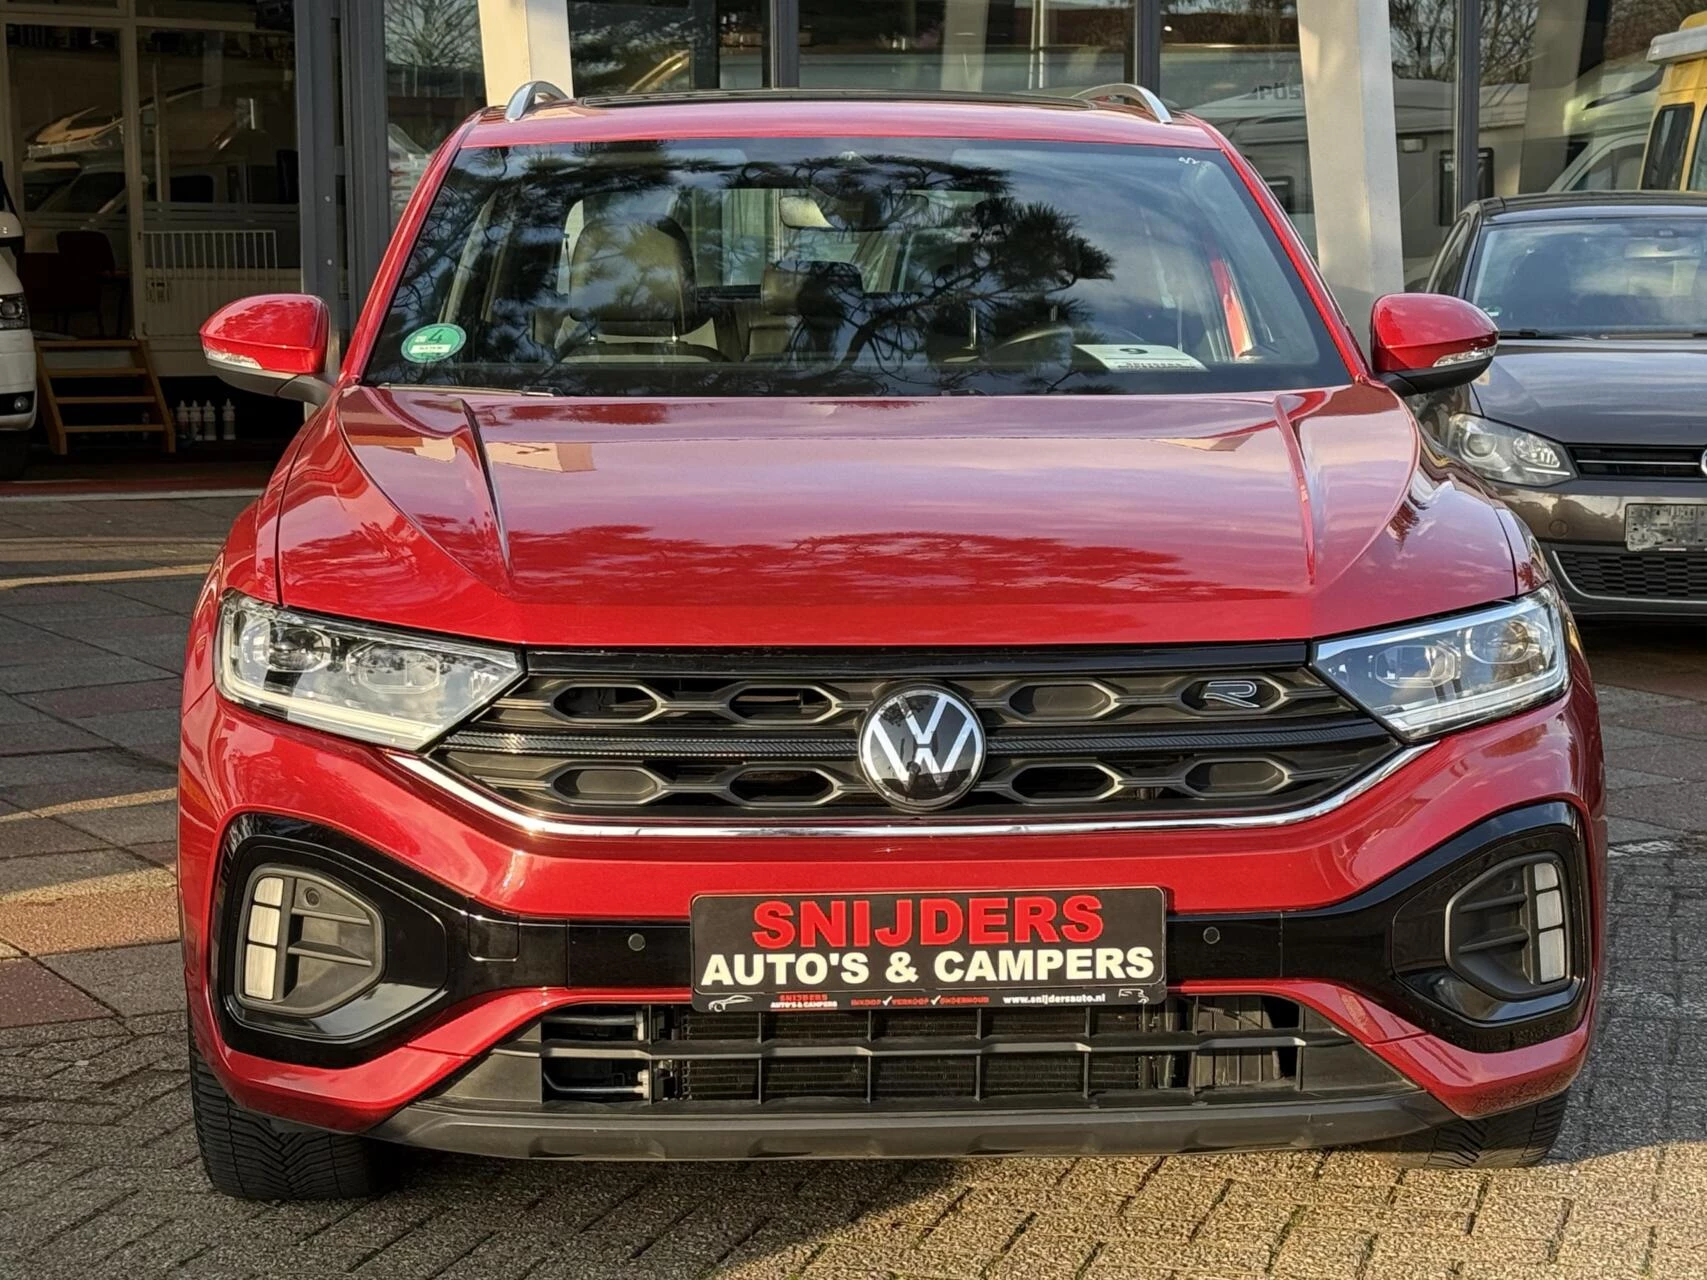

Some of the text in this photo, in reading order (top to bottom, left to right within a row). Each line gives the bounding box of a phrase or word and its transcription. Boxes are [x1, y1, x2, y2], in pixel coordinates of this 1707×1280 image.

[752, 894, 1104, 949] SNIJDERS
[700, 946, 1155, 986] AUTO'S & CAMPERS
[1003, 992, 1106, 1005] www.snijdersauto.nl
